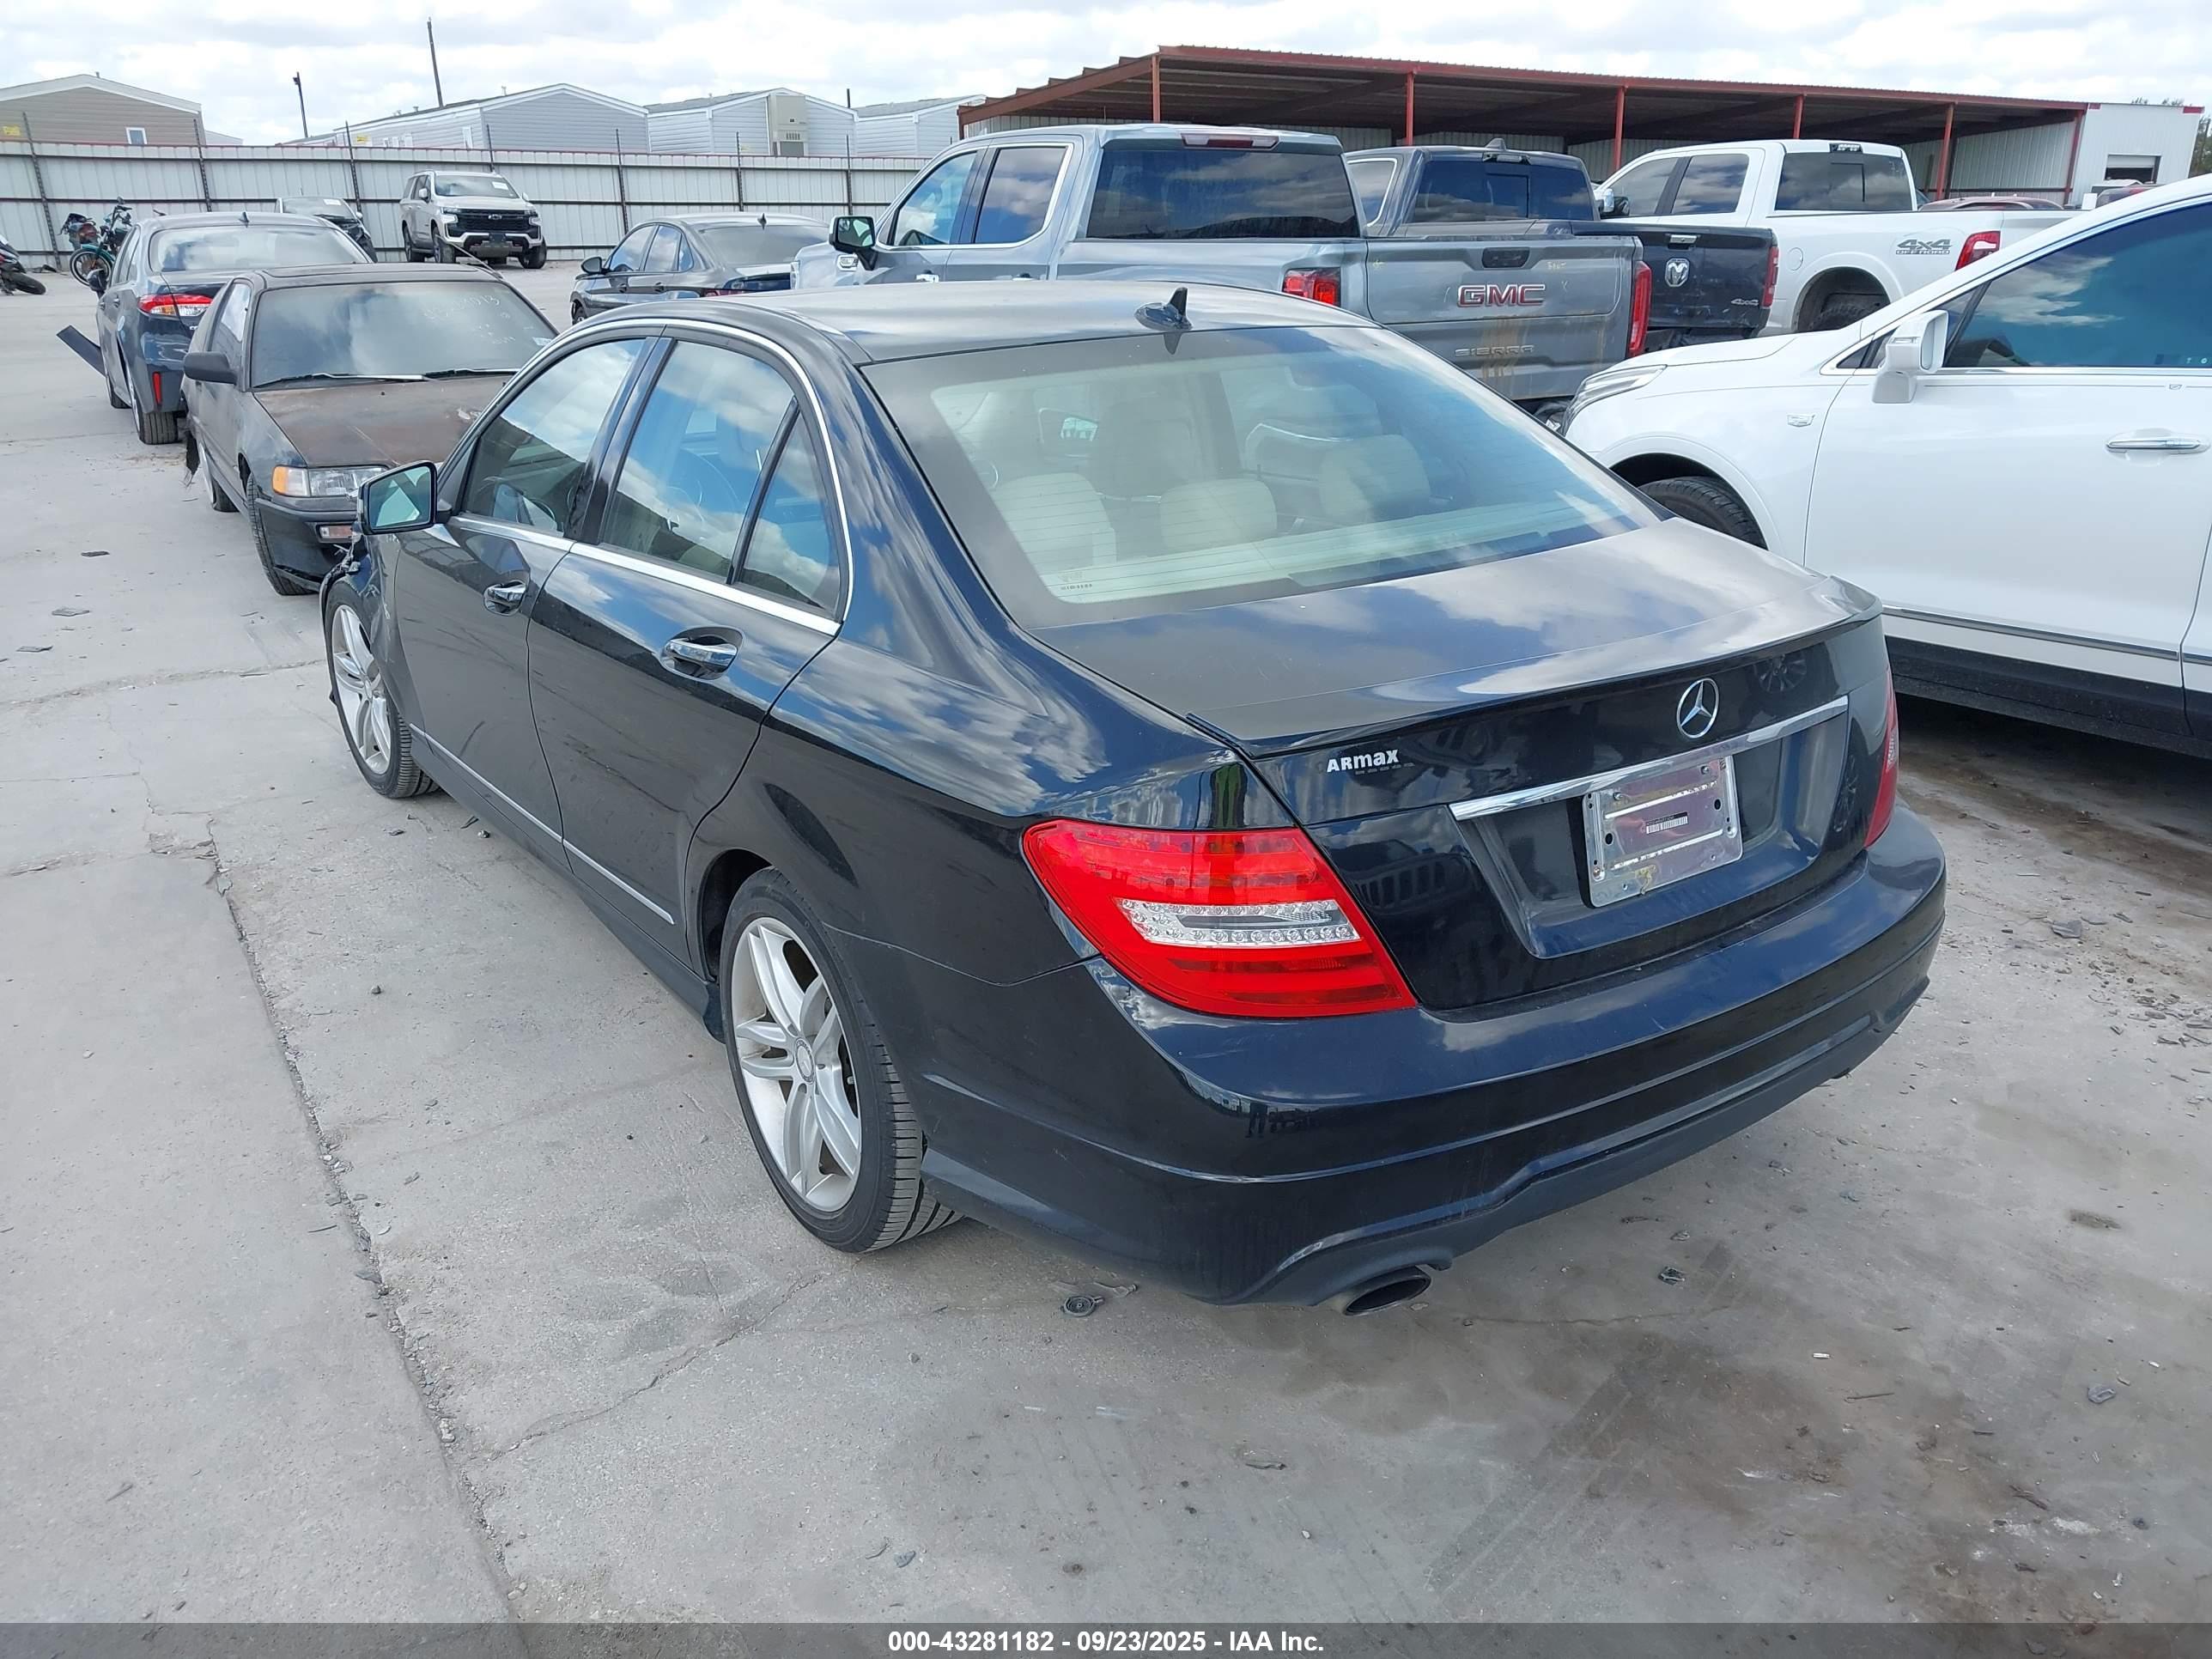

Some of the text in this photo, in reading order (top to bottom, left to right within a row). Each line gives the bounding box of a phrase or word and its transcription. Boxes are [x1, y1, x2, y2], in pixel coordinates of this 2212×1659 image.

[1897, 239, 1953, 250] 4x4
[1457, 284, 1546, 307] GMC
[1455, 344, 1535, 356] SIERRA
